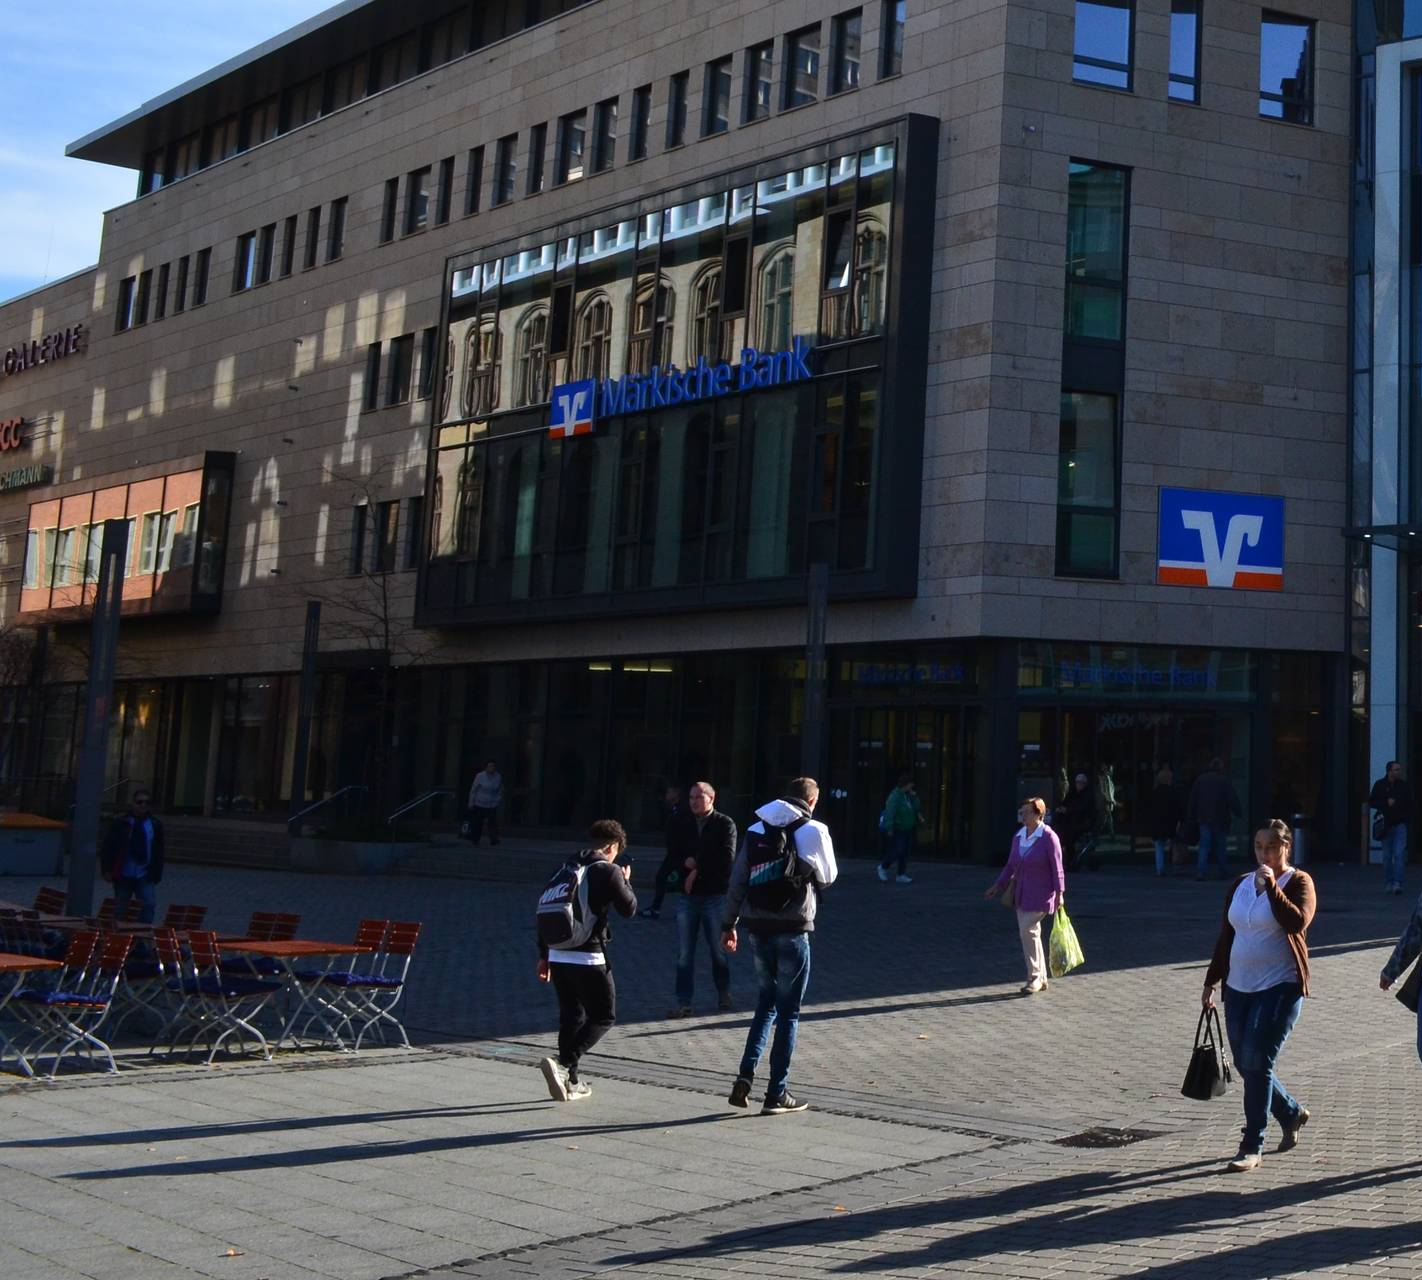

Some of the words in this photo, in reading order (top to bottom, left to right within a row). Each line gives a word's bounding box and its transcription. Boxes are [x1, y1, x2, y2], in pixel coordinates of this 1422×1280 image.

[3, 323, 83, 377] GALERIE
[602, 355, 731, 417] Märkische
[739, 336, 811, 391] Bank
